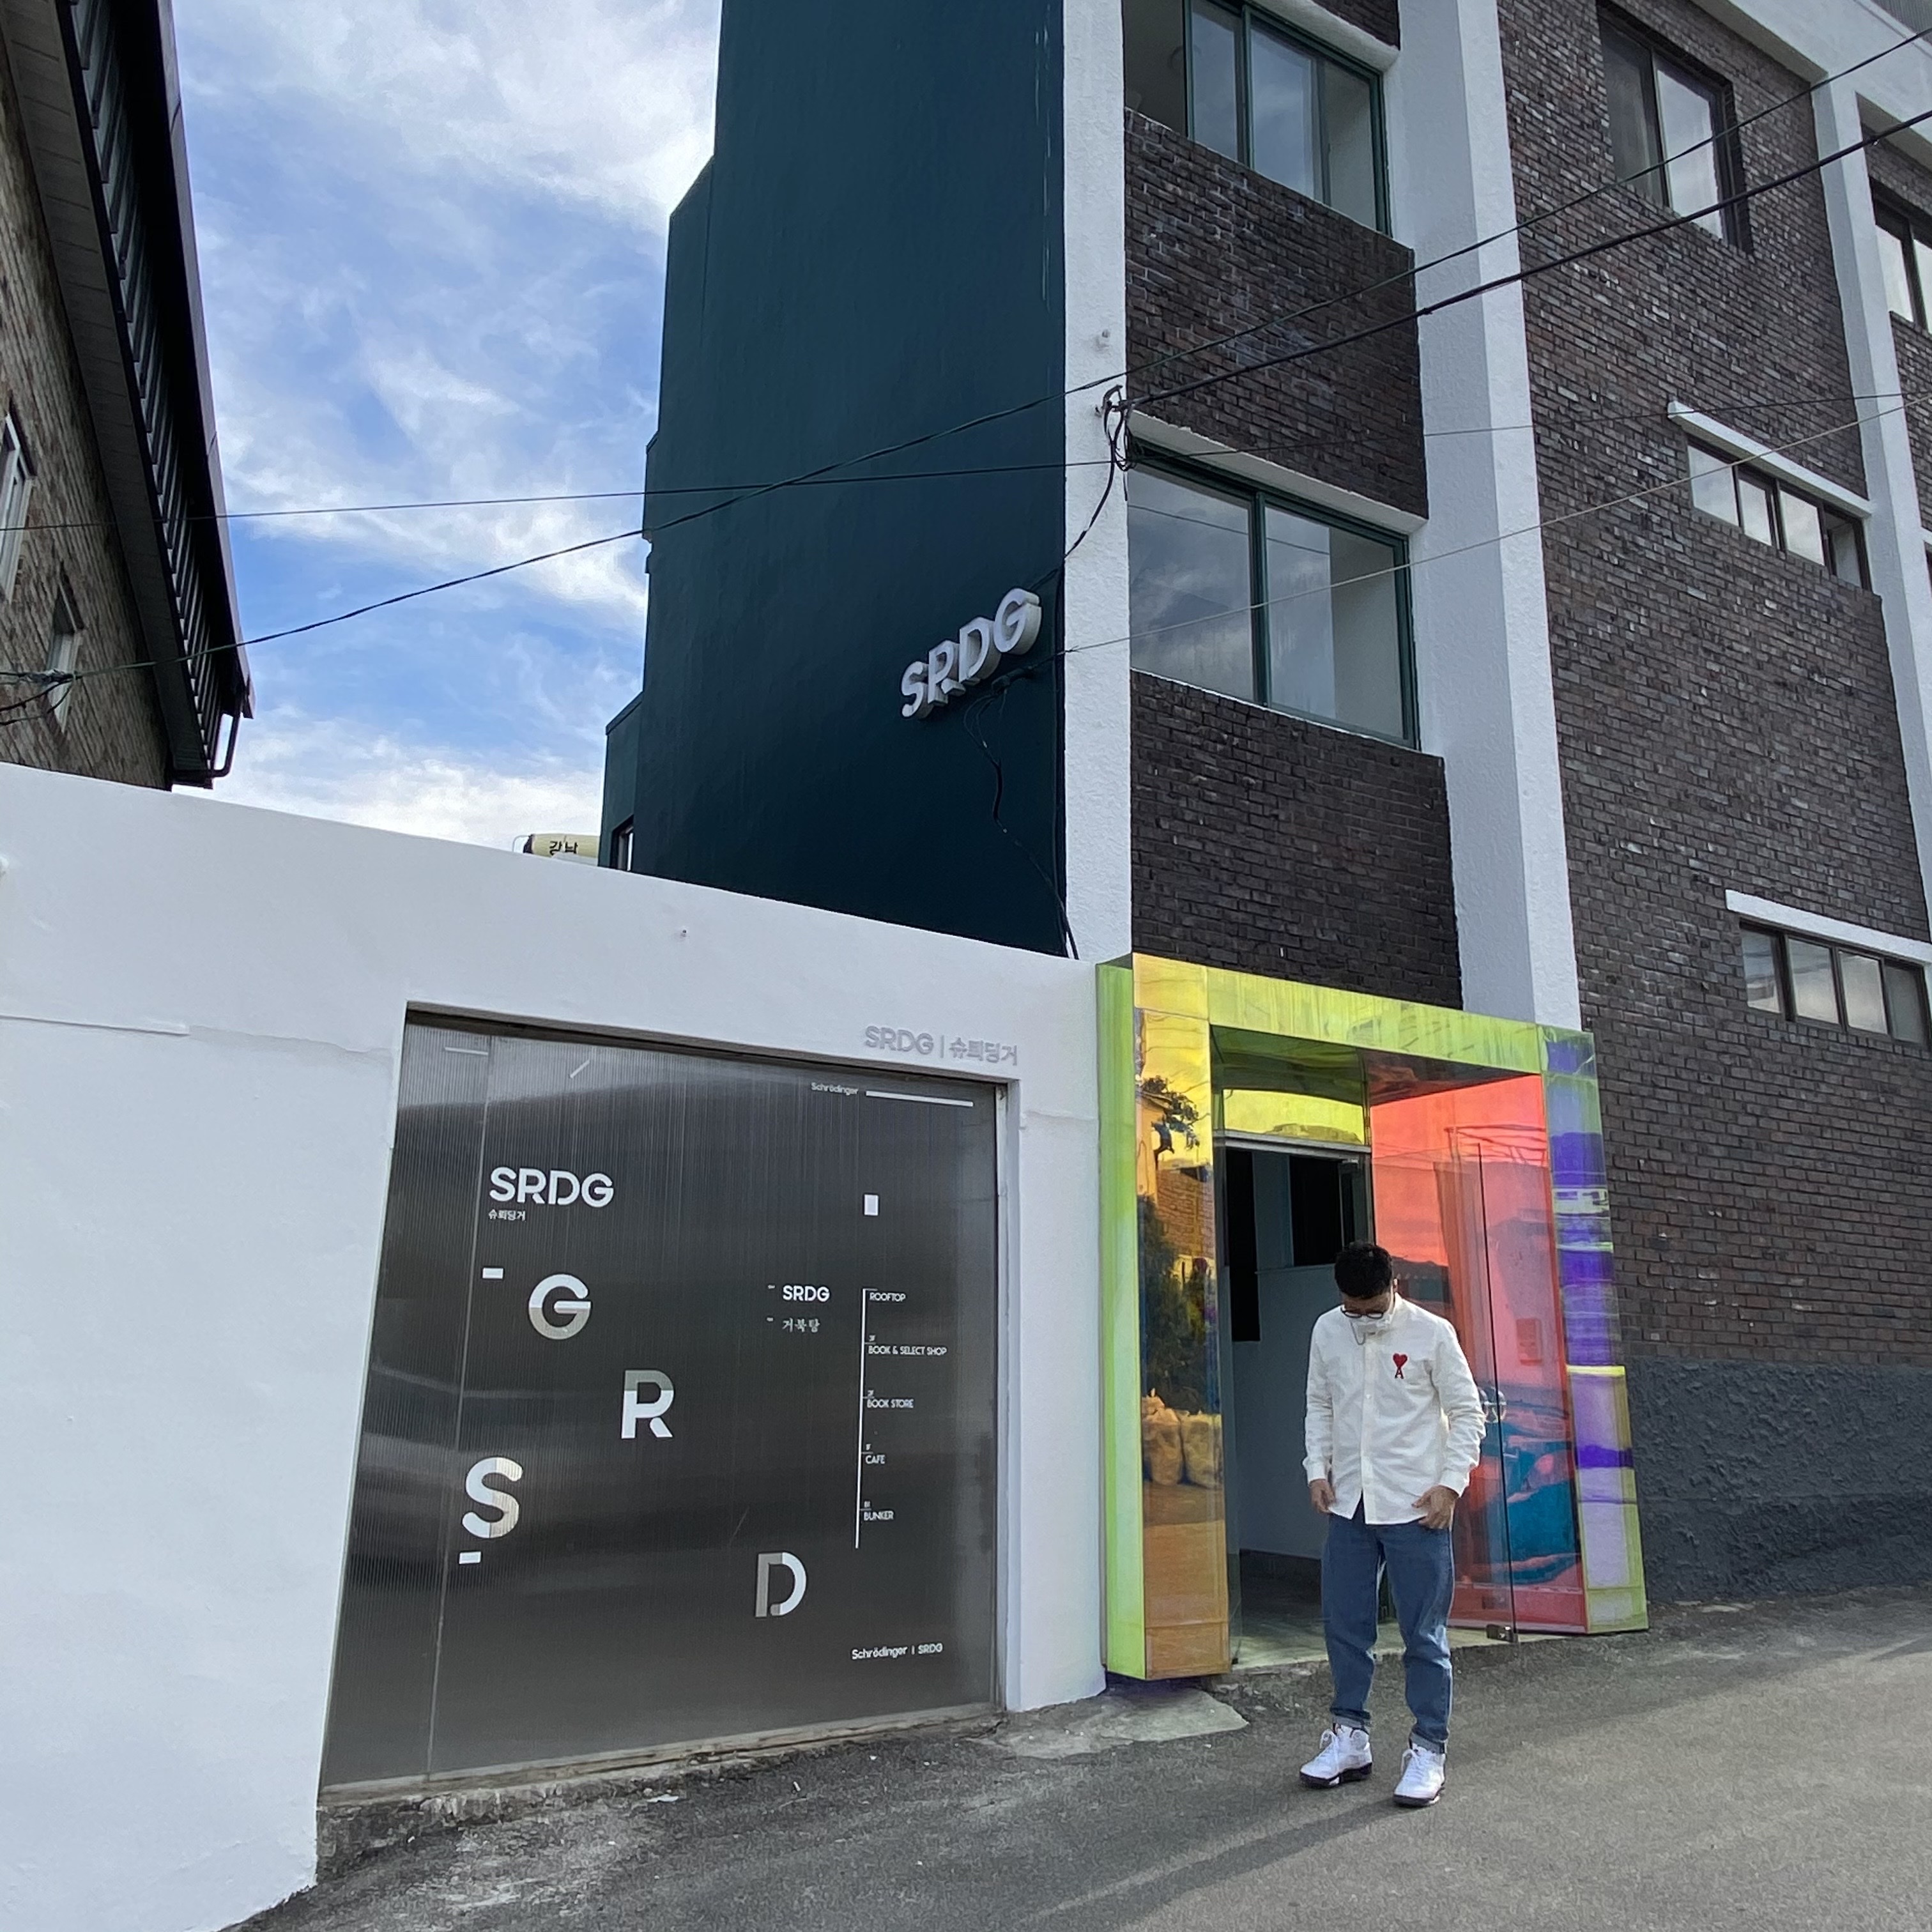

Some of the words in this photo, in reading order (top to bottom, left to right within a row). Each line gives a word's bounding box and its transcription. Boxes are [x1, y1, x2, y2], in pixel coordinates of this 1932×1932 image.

[901, 588, 1042, 719] SRDG
[865, 1025, 934, 1055] SRDG
[489, 1167, 614, 1208] SRDG
[782, 1285, 831, 1302] SRDG
[869, 1292, 906, 1302] ROOFTOP
[528, 1273, 592, 1340] G
[868, 1345, 891, 1354] BOOK
[900, 1346, 925, 1355] SELECT
[926, 1346, 947, 1356] SHOP
[621, 1370, 674, 1439] R
[866, 1399, 889, 1408] BOOK
[891, 1399, 914, 1409] STORE
[865, 1455, 885, 1464] CAFE
[462, 1457, 523, 1538] S
[863, 1510, 894, 1521] BUNKER
[755, 1552, 807, 1618] D
[918, 1643, 943, 1654] SRDG
